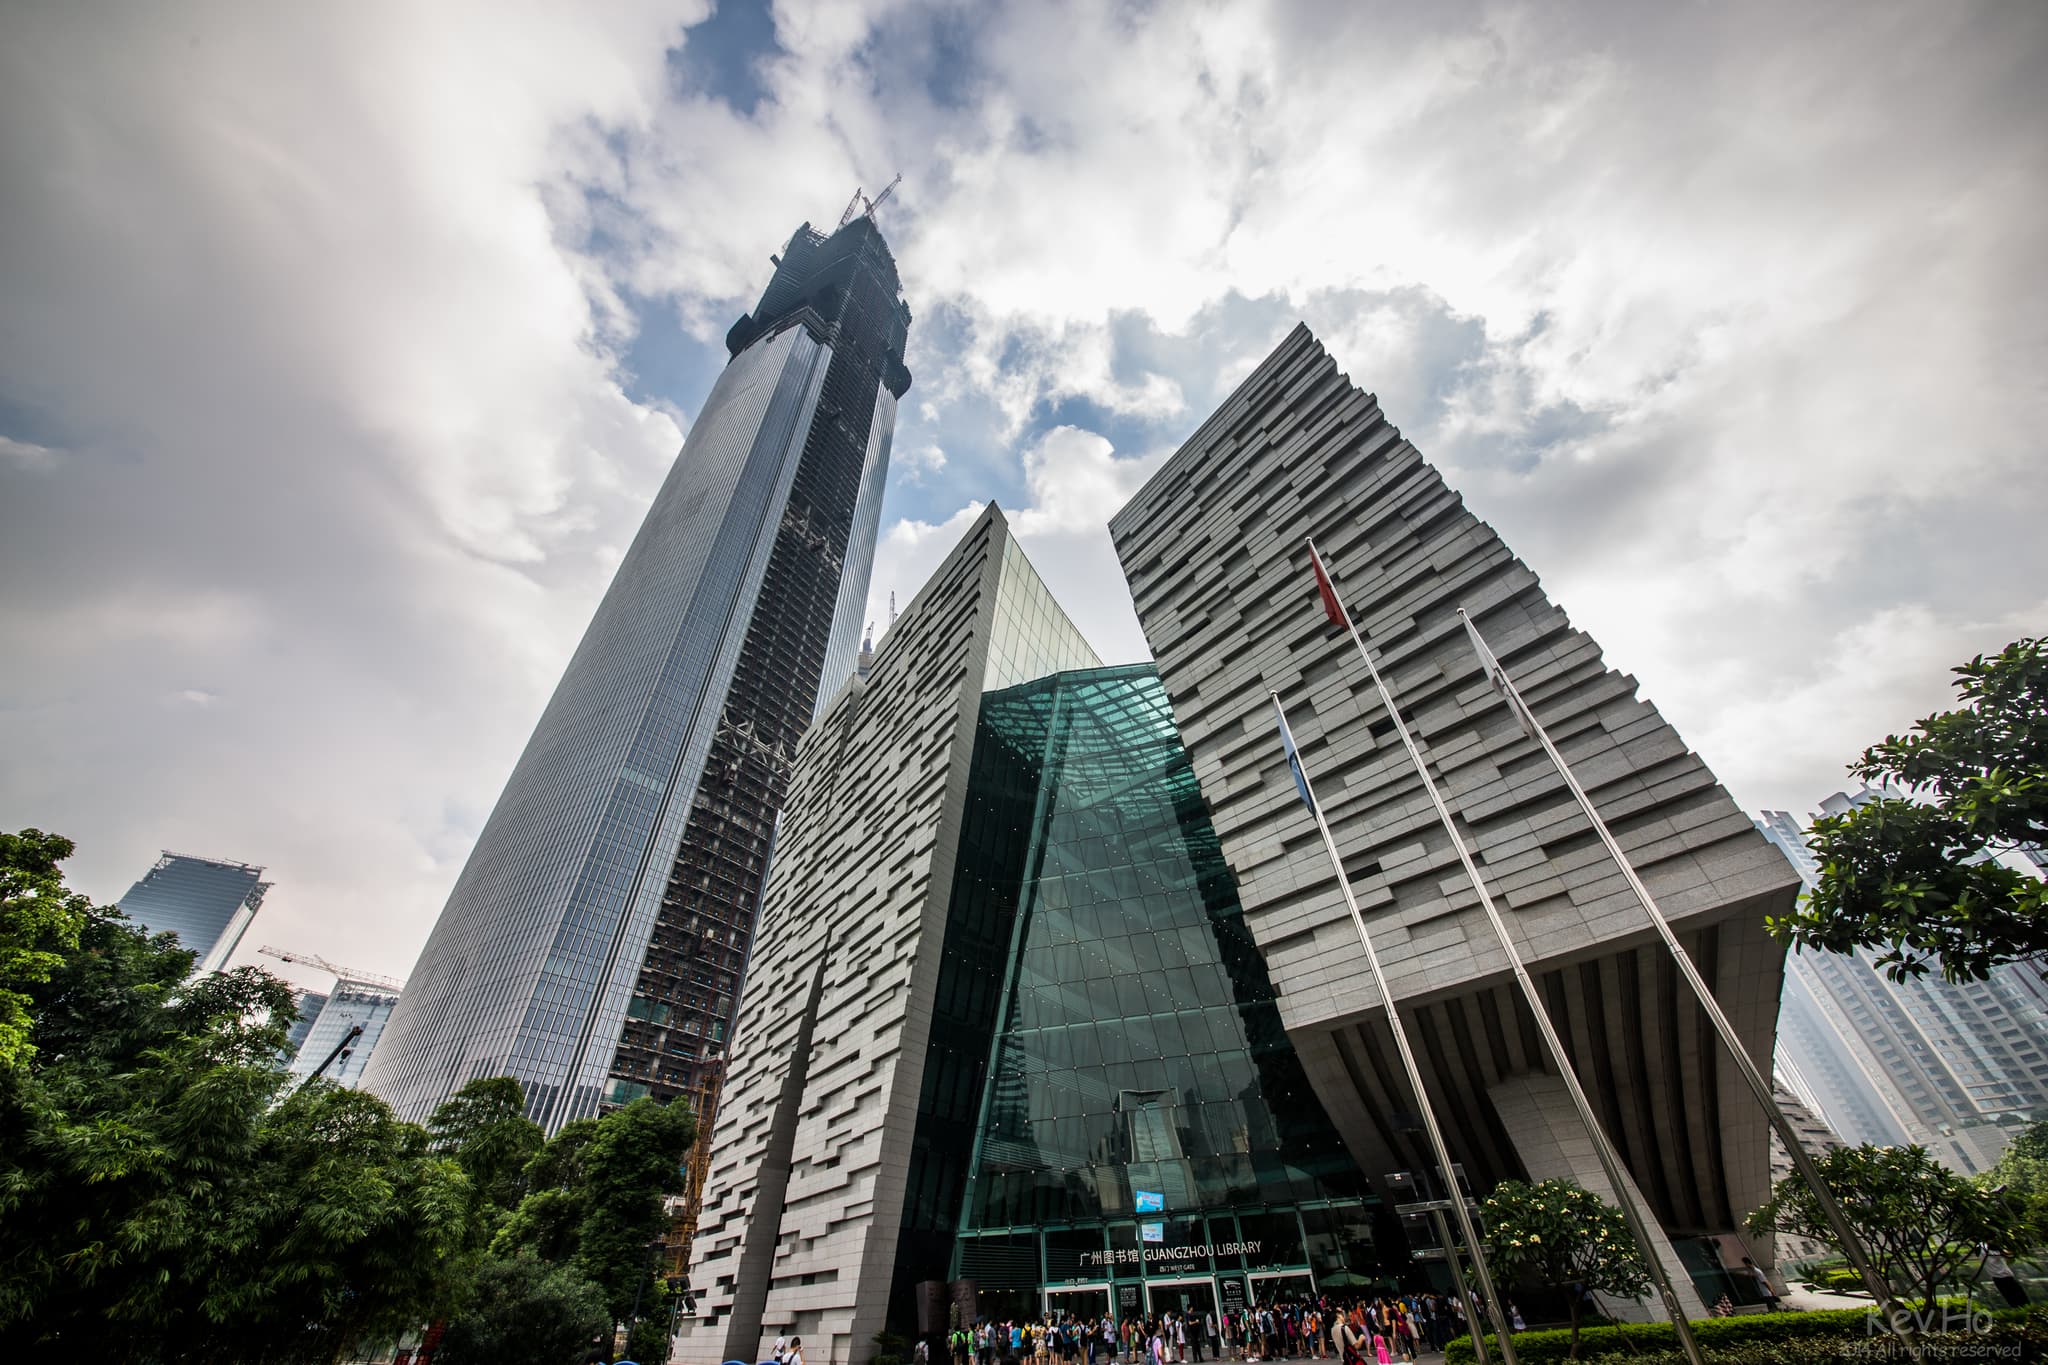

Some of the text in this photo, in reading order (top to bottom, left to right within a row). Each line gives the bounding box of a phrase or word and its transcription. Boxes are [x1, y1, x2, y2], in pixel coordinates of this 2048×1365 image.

[1079, 1240, 1261, 1267] 广州图书馆 GUANGZHOU LIBRARY
